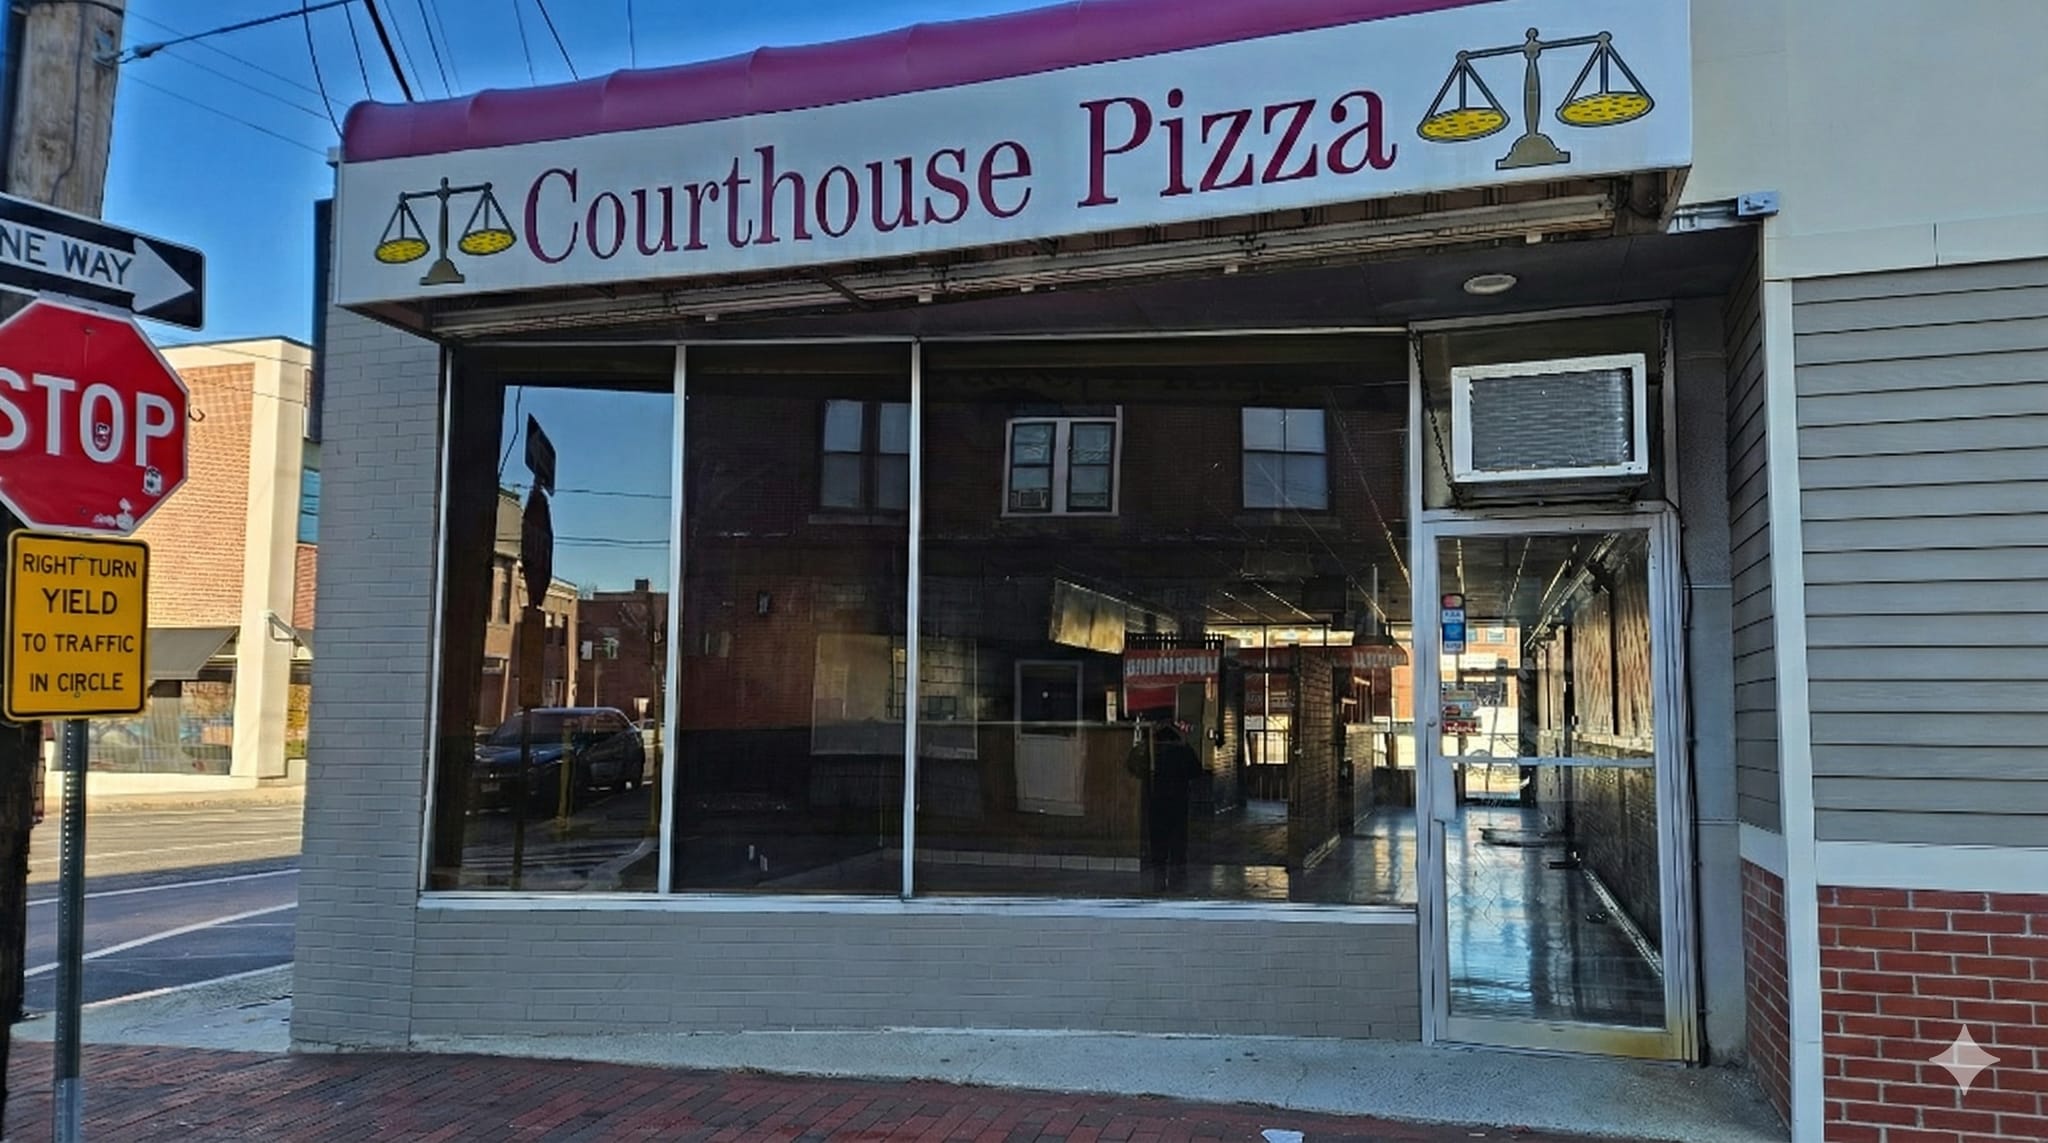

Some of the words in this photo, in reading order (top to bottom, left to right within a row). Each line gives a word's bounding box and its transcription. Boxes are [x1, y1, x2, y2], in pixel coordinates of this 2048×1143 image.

[524, 139, 1033, 264] Courthouse
[1077, 88, 1398, 208] Pizza
[61, 239, 133, 286] WAY
[0, 366, 175, 467] STOP
[23, 553, 80, 575] RIGHT
[89, 558, 137, 578] TURN
[42, 588, 118, 615] YIELD
[22, 633, 46, 652] TO
[54, 634, 135, 653] TRAFFIC
[30, 673, 48, 692] IN
[57, 673, 124, 692] CIRCLE
